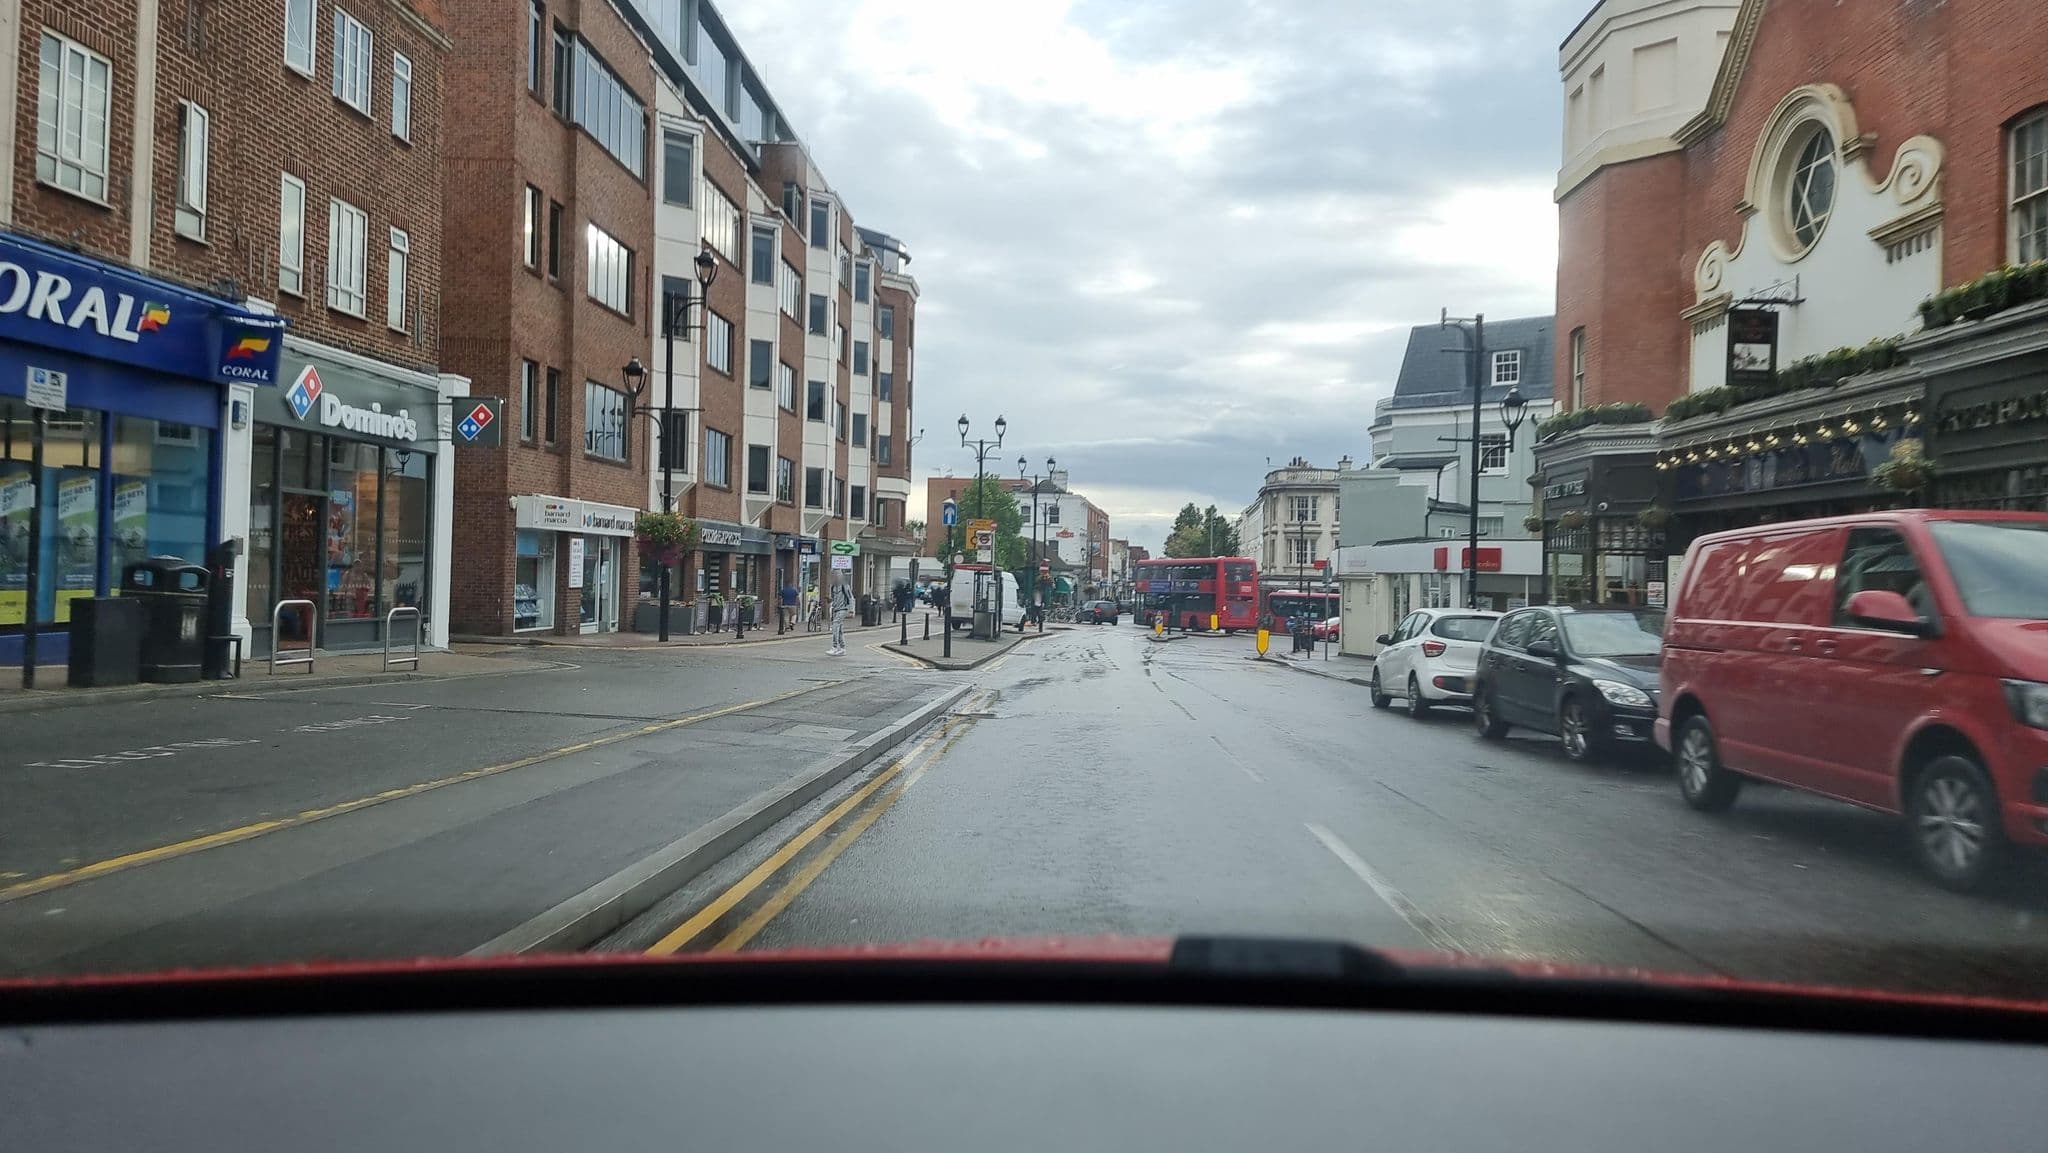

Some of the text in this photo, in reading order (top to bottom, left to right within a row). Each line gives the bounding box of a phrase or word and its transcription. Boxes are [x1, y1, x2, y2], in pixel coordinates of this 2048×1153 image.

[222, 364, 269, 380] CORAL
[320, 392, 417, 441] Domino's
[544, 510, 571, 518] barnard
[593, 512, 615, 529] barnard
